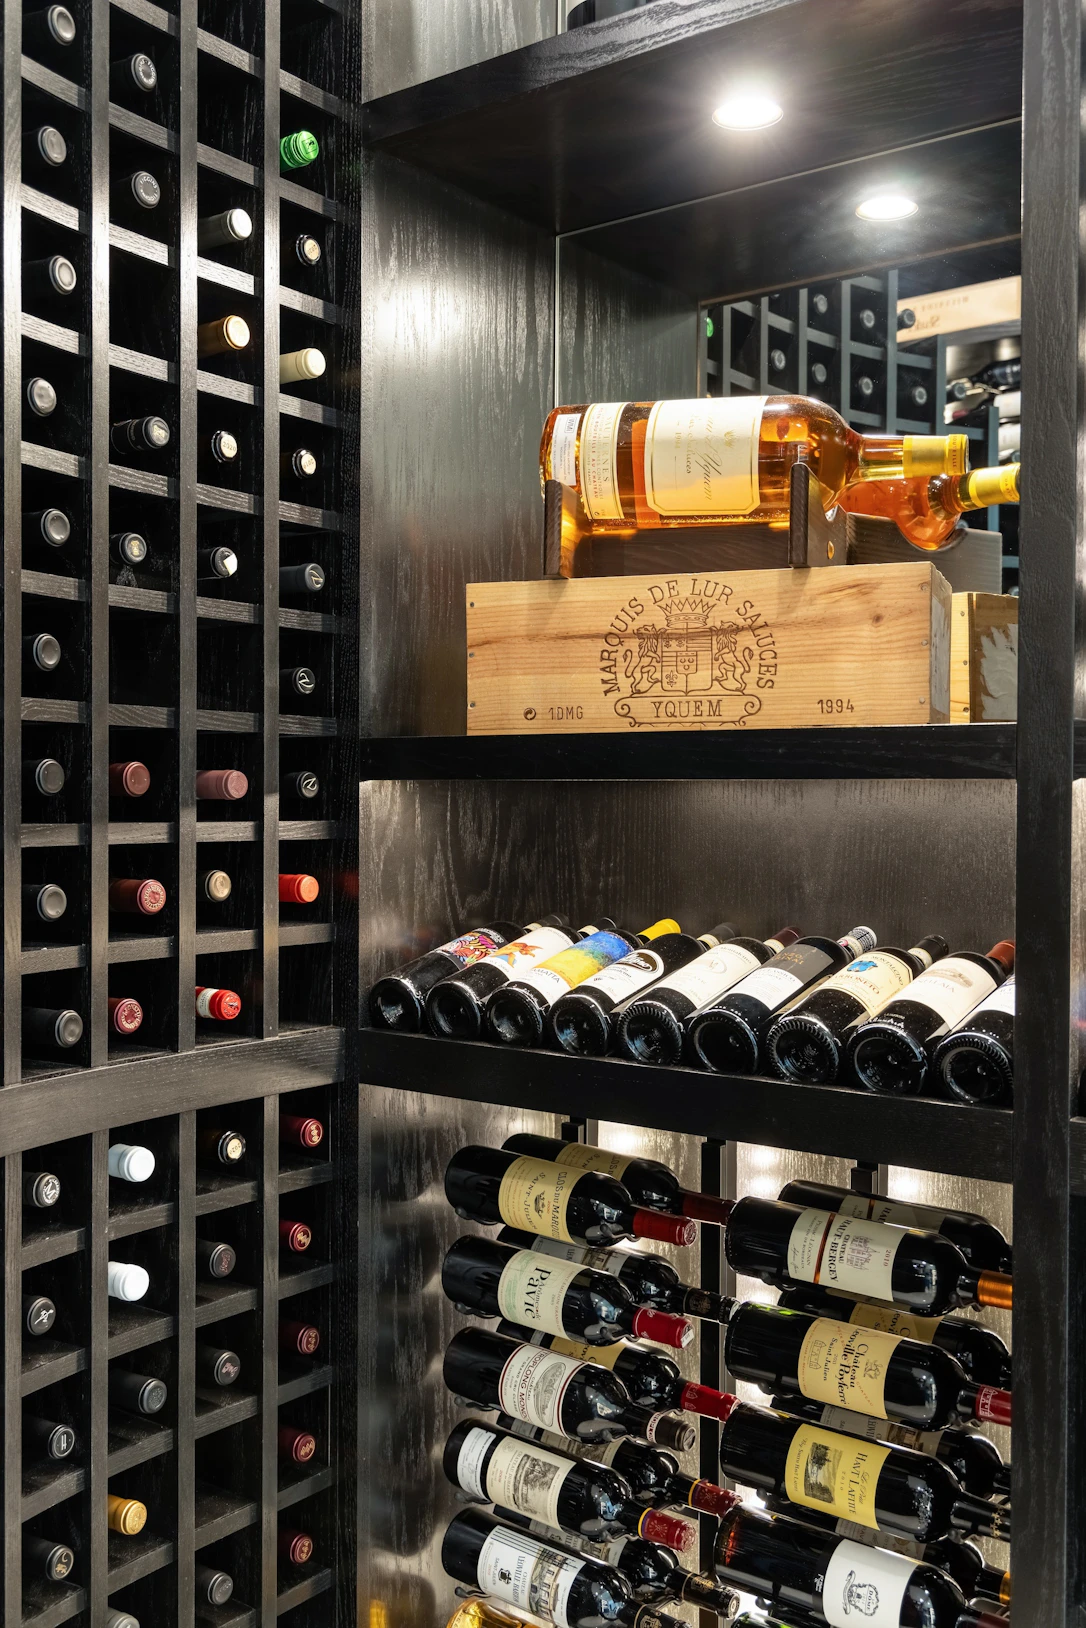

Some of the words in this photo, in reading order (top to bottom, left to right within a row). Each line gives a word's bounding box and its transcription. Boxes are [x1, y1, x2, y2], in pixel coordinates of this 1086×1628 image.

[591, 458, 597, 468] AU
[600, 597, 645, 696] MARQUIS
[648, 579, 679, 605] DE
[690, 578, 734, 606] LUR
[735, 600, 777, 689] SALUCES
[548, 705, 583, 720] 1DMG
[817, 698, 854, 714] 1994
[651, 699, 723, 718] YQUEM
[555, 1171, 568, 1192] CLOS
[523, 1172, 546, 1230] SAINT-JULIEN
[553, 1192, 560, 1203] DU
[828, 1219, 853, 1282] HAUT-BERGEY
[883, 1249, 892, 1267] 2010
[523, 1267, 552, 1319] Pavie
[827, 1337, 838, 1356] Saint
[520, 1351, 548, 1389] TROPLONG
[823, 1357, 832, 1381] Julien
[850, 1343, 869, 1388] Château
[835, 1363, 851, 1405] Poyferré
